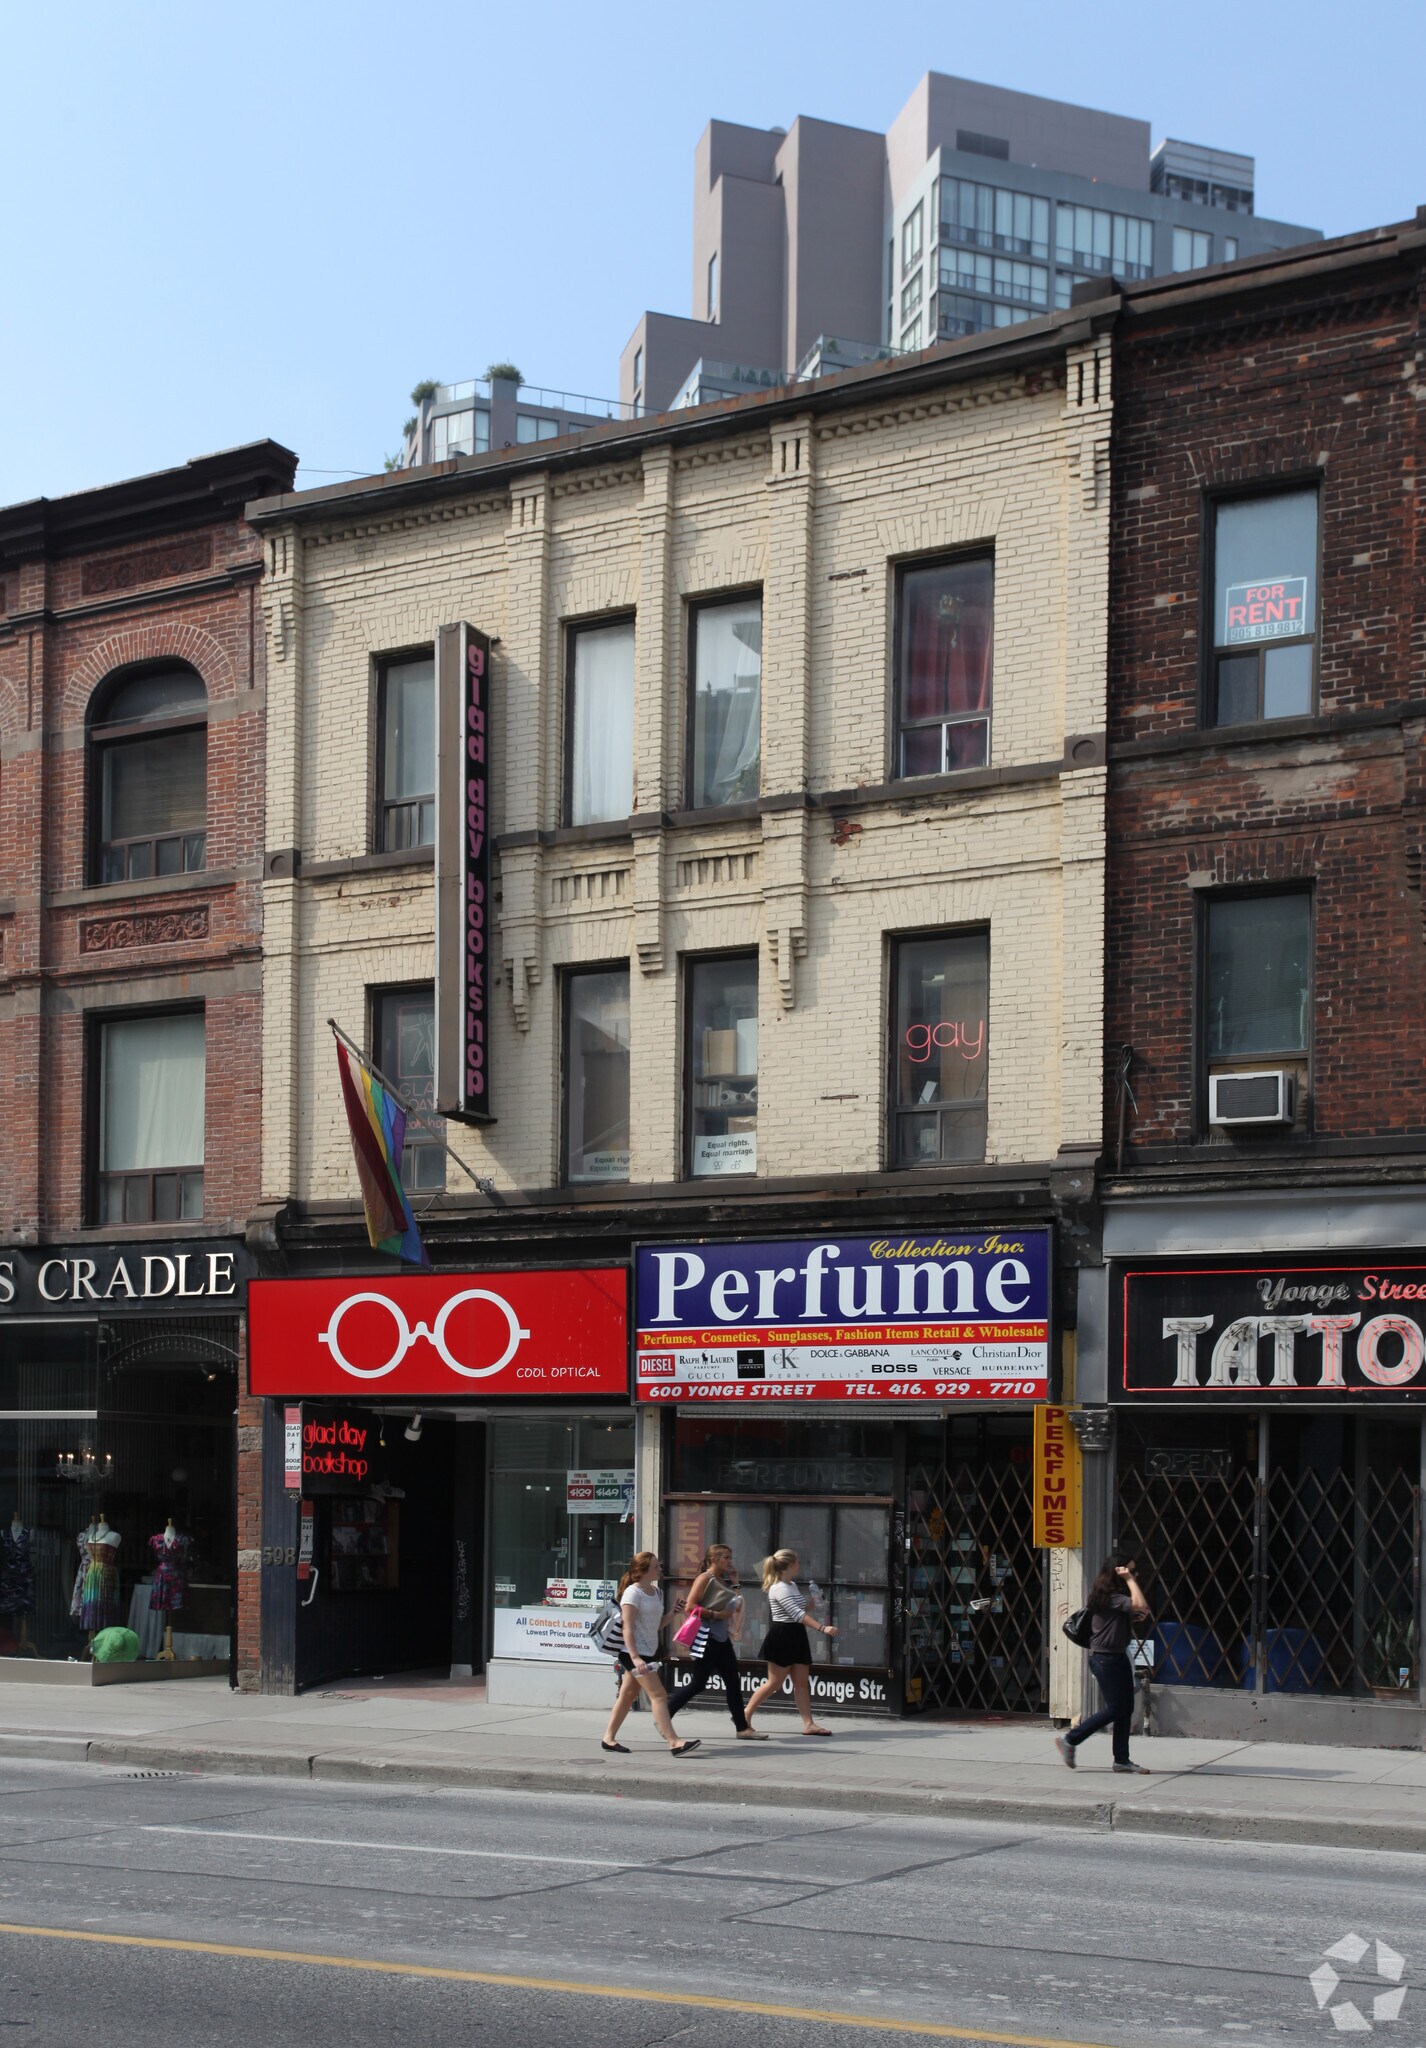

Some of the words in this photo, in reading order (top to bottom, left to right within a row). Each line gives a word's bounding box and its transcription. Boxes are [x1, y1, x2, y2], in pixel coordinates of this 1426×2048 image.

[1246, 585, 1285, 602] FOR
[1229, 598, 1301, 627] RENT
[1232, 628, 1251, 640] 905
[1255, 625, 1274, 636] 819
[1277, 621, 1303, 632] 9812
[467, 872, 484, 1097] bookshop
[906, 1020, 983, 1062] gay
[400, 1080, 434, 1096] GLA
[708, 1141, 726, 1149] Equal
[728, 1140, 750, 1148] rights.
[595, 1156, 615, 1164] Equal
[702, 1150, 720, 1158] Equal
[722, 1149, 753, 1157] marriage.
[870, 1239, 977, 1259] Collection
[978, 1235, 1024, 1255] Inc.
[38, 1253, 236, 1300] CRADLE
[650, 1244, 1030, 1321] Perfume
[1256, 1278, 1350, 1310] Yonge
[644, 1334, 696, 1345] Perfumes,
[701, 1332, 760, 1344] Cosmetics,
[768, 1331, 832, 1343] Sunglasses,
[836, 1329, 882, 1340] Fashion
[885, 1328, 919, 1339] Items
[923, 1327, 959, 1338] Retail
[963, 1327, 975, 1338] &
[979, 1326, 1044, 1338] Wholesale
[811, 1350, 838, 1358] DOLCE
[844, 1349, 889, 1357] GABBANA
[1162, 1312, 1425, 1386] TATTO
[641, 1359, 673, 1372] DIESEL
[680, 1355, 699, 1364] RALPH
[711, 1355, 734, 1364] LAUREN
[516, 1368, 547, 1378] COOL
[551, 1367, 600, 1377] OPTICAL
[872, 1364, 917, 1373] BOSS
[933, 1367, 971, 1375] VERSACE
[649, 1386, 682, 1397] 600
[688, 1385, 745, 1396] YONGE
[750, 1384, 816, 1396] STREET
[845, 1384, 881, 1395] TEL.
[889, 1383, 926, 1395] 416.
[935, 1383, 970, 1395] 929
[990, 1382, 1035, 1394] 7710
[304, 1419, 336, 1449] glad
[339, 1420, 367, 1451] day
[303, 1451, 368, 1481] bookshop
[1150, 1453, 1223, 1471] OPEN
[1043, 1408, 1066, 1544] PERFUMES
[570, 1488, 592, 1497] $129
[596, 1488, 619, 1497] $149
[263, 1547, 296, 1566] 598
[516, 1618, 527, 1626] All
[529, 1618, 560, 1627] Contact
[563, 1620, 582, 1628] Lens
[540, 1642, 590, 1650] www.cooloptical.ca
[808, 1676, 854, 1703] Yonge
[860, 1678, 886, 1700] Str.
